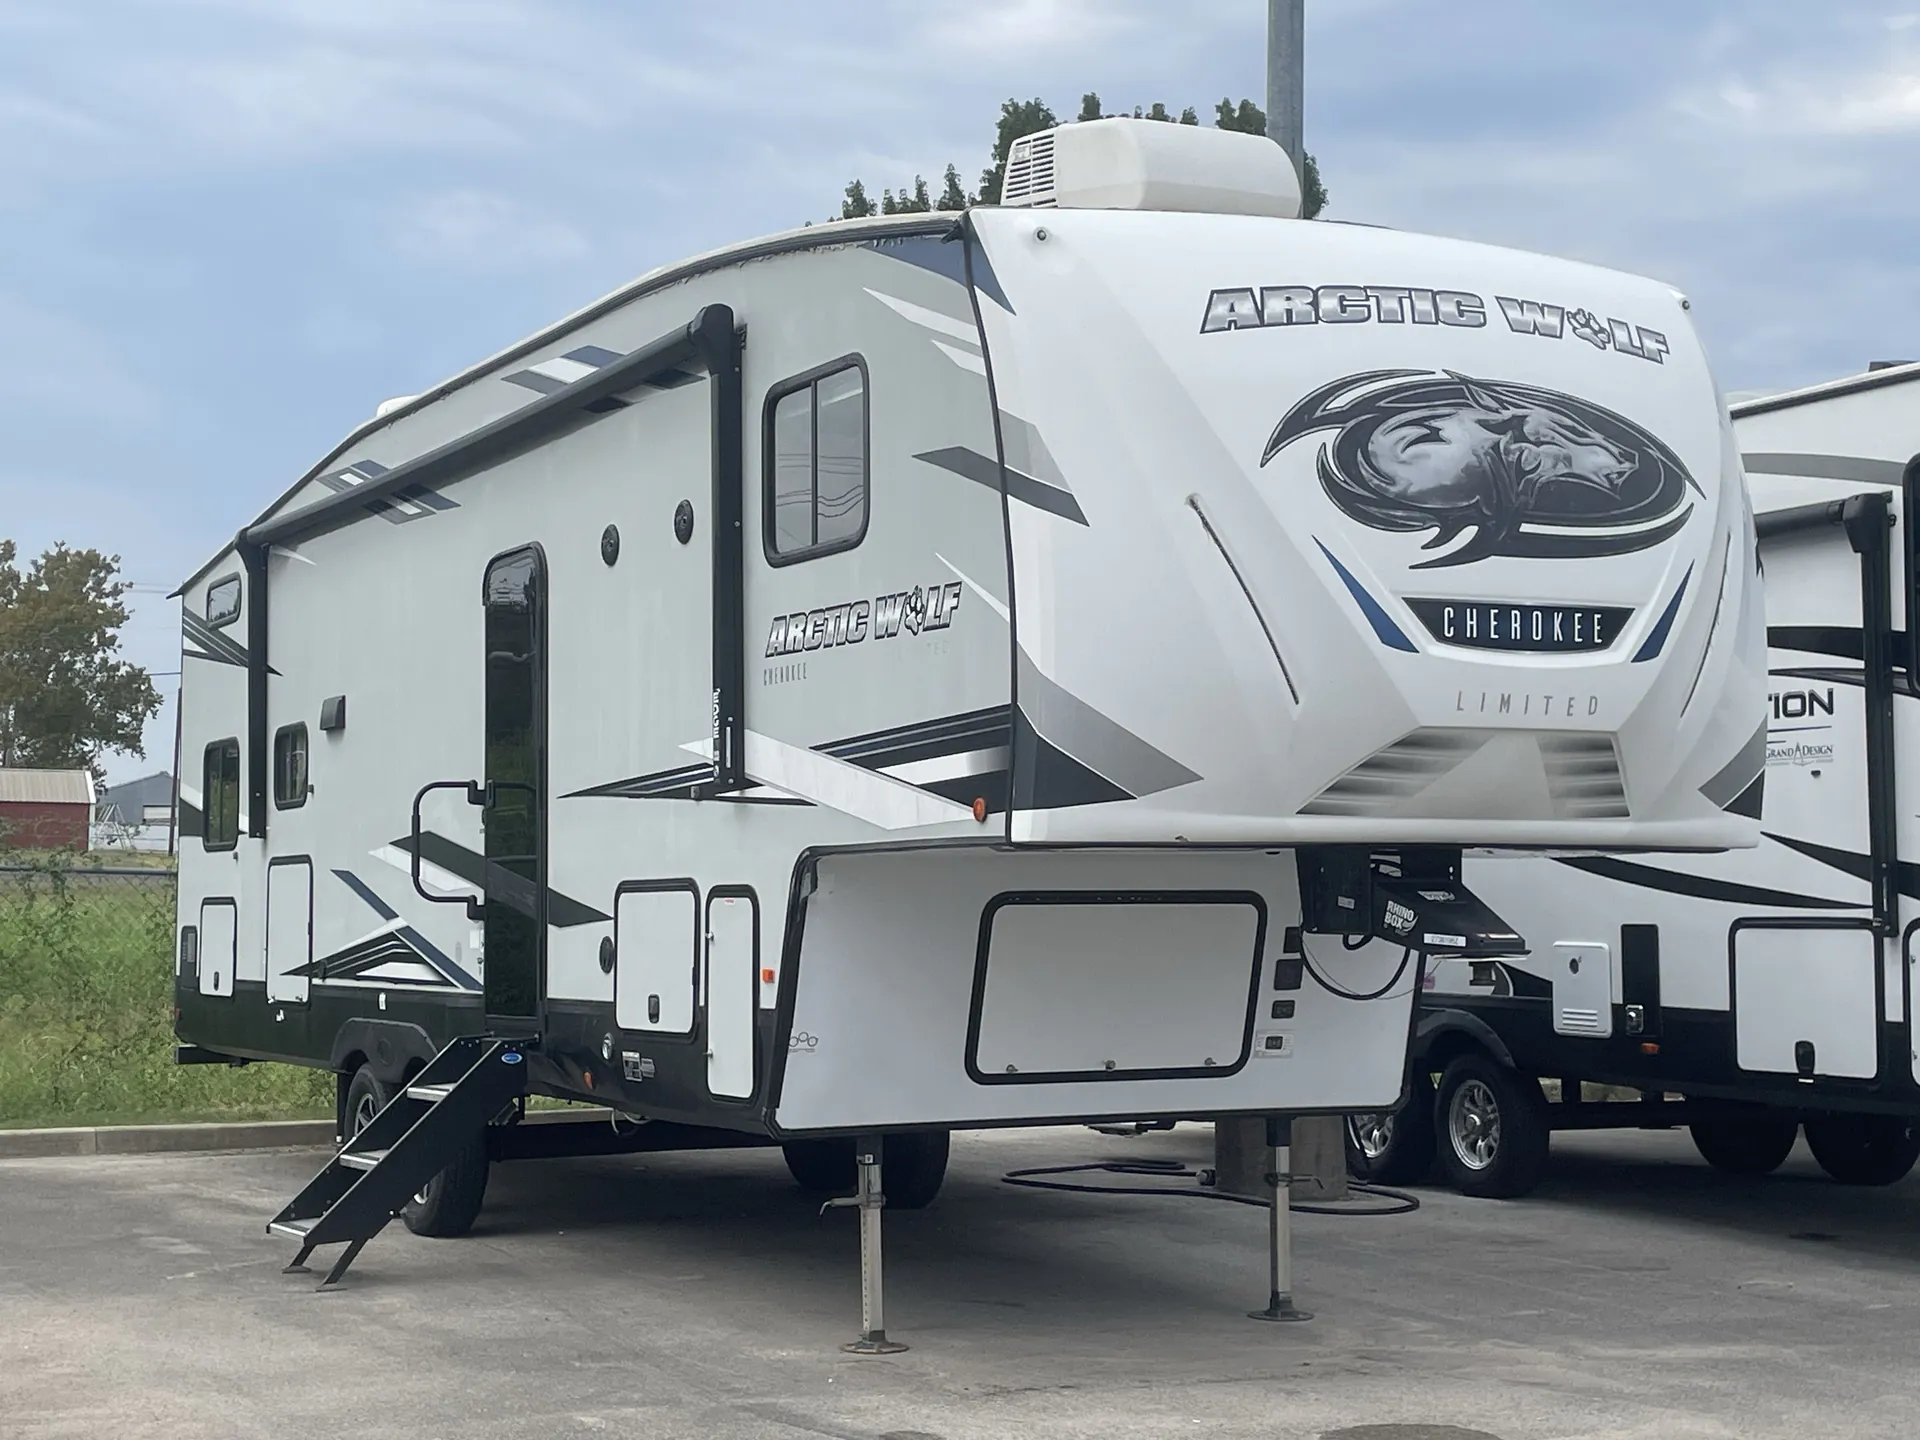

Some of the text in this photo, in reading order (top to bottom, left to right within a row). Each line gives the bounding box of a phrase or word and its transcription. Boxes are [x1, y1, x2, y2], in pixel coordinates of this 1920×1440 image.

[1200, 285, 1487, 333] ARCTIC
[765, 600, 869, 658] ARCTIC
[1442, 606, 1605, 644] CHEROKEE
[763, 661, 808, 687] CHEROKEE
[1456, 690, 1599, 717] LIMITED
[1802, 744, 1834, 756] DESIGN
[1384, 911, 1403, 930] BOX
[1387, 900, 1415, 922] RHINO
